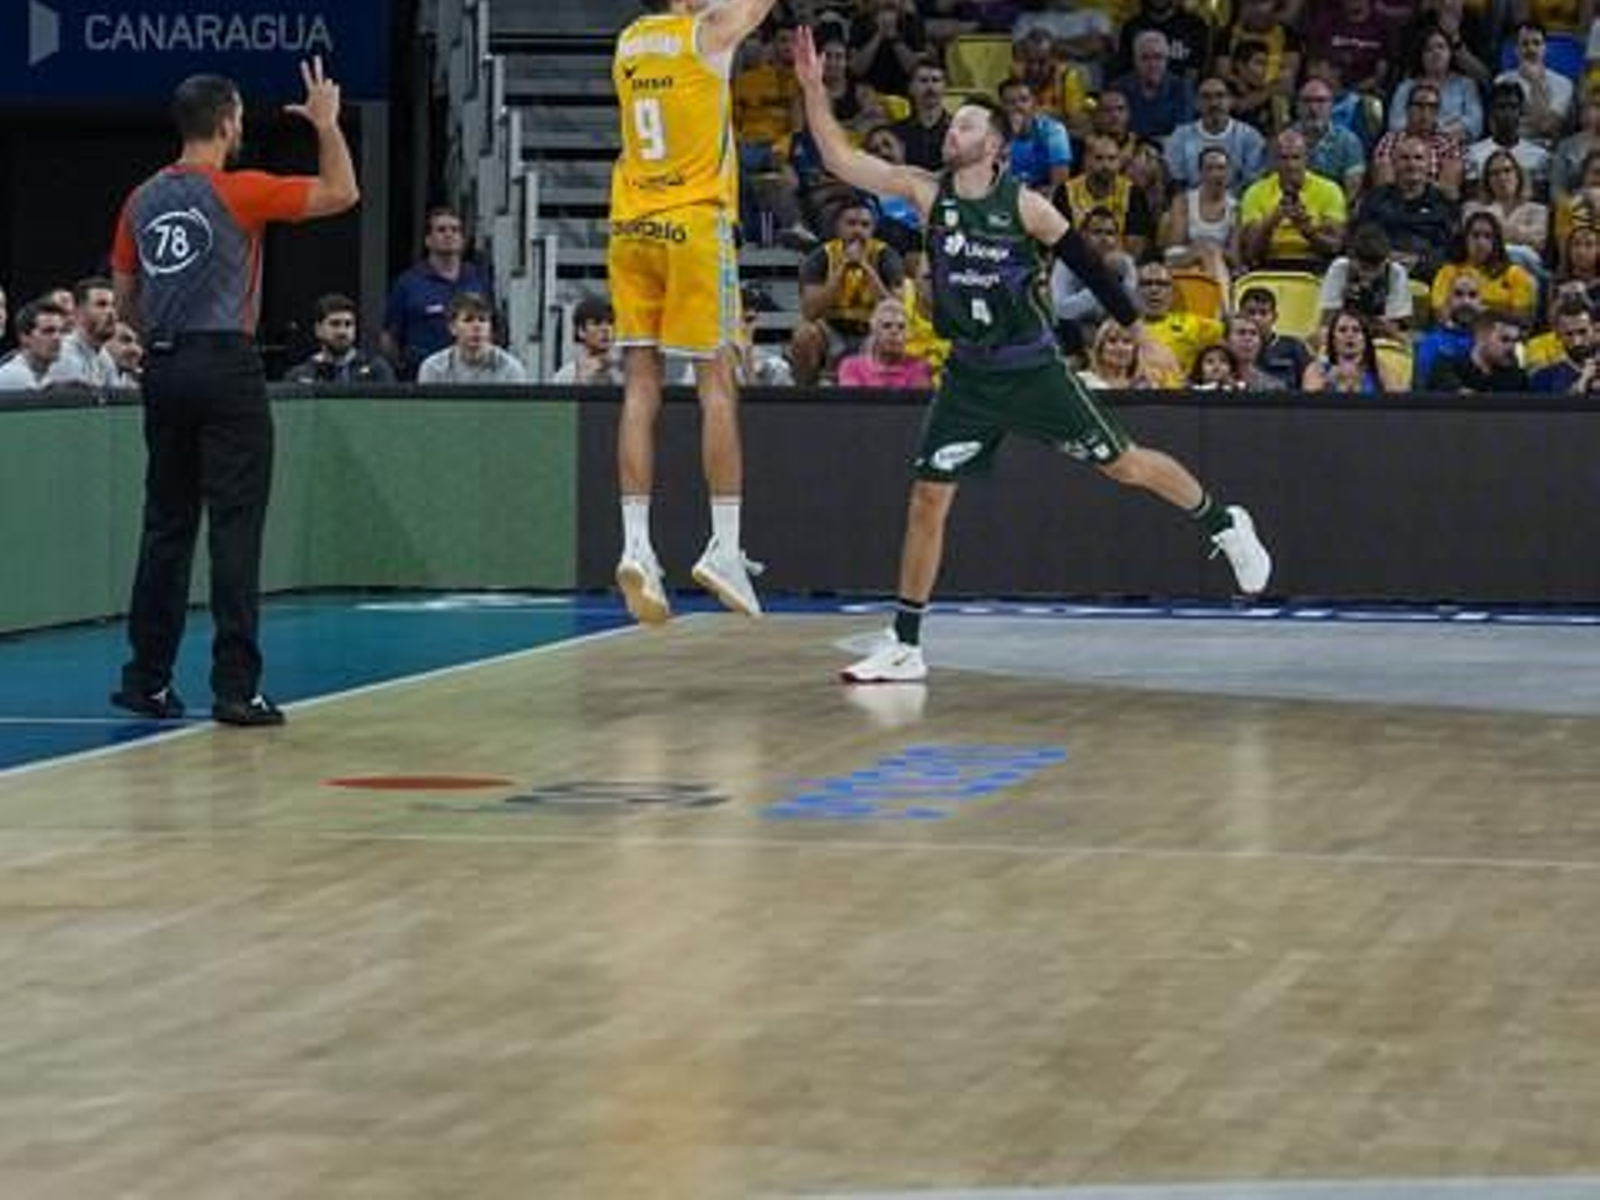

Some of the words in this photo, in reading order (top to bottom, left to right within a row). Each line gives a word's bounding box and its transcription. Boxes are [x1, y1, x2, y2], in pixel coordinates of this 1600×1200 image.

[84, 13, 333, 51] CANARAGUA
[633, 98, 666, 160] 9
[155, 225, 190, 259] 78
